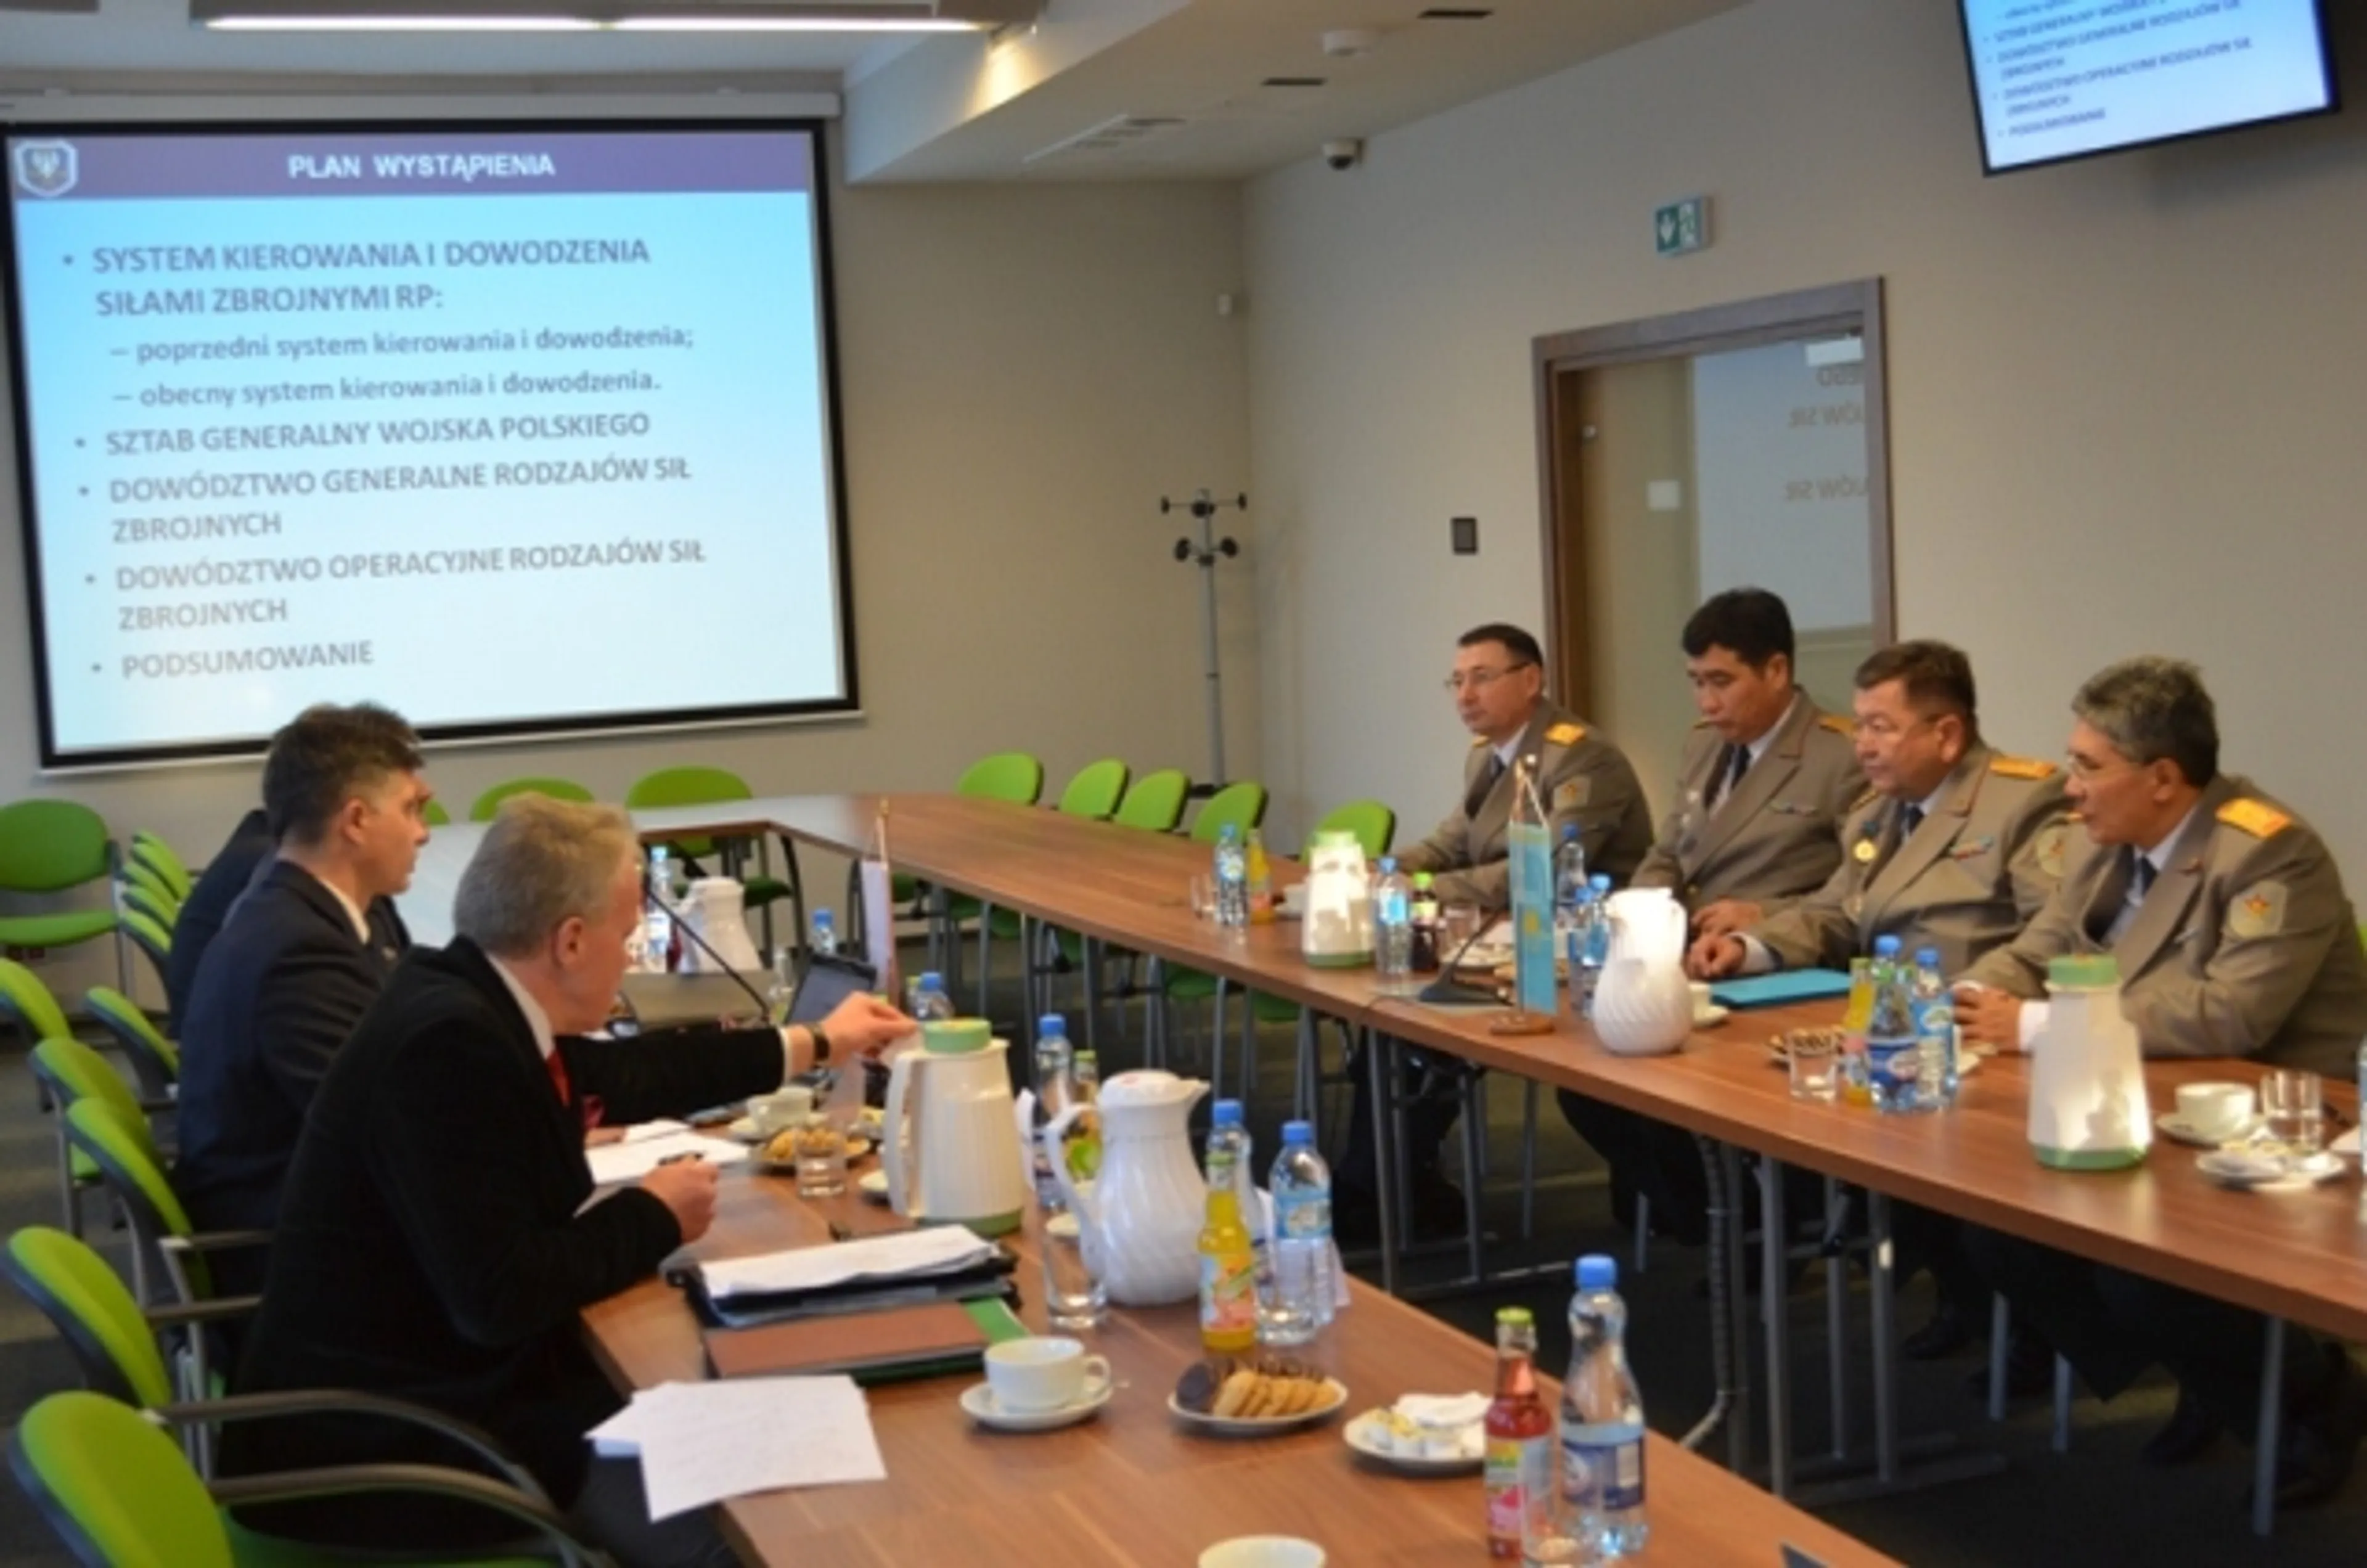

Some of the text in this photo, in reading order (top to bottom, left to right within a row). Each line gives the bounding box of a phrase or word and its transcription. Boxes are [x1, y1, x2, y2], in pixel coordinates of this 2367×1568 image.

[287, 153, 557, 183] PLAN WYSTĄPIENIA
[92, 238, 650, 274] SYSTEM KIEROWANIA I DOWODZENIA
[95, 284, 444, 317] SIŁAMI ZBROJNYMI RP:
[136, 333, 270, 365] poprzedni
[276, 333, 368, 363] system
[373, 329, 515, 355] kierowania
[535, 325, 694, 351] dowodzenia;
[139, 382, 236, 408] obecny
[241, 380, 333, 407] system
[340, 373, 483, 401] kierowania
[502, 370, 661, 396] dowodzenia.
[105, 411, 651, 457] SZTAB GENERALNY WOJSKA POLSKIEGO
[108, 453, 693, 504] DOWÓDZTWO GENERALNE RODZAJÓW SIŁ
[112, 511, 284, 544] ZBROJNYCH
[115, 536, 707, 592] DOWÓDZTWO OPERACYJNE RODZAJÓW SIŁ
[118, 598, 289, 632] ZBROJNYCH
[121, 640, 375, 679] PODSUMOWANIE
